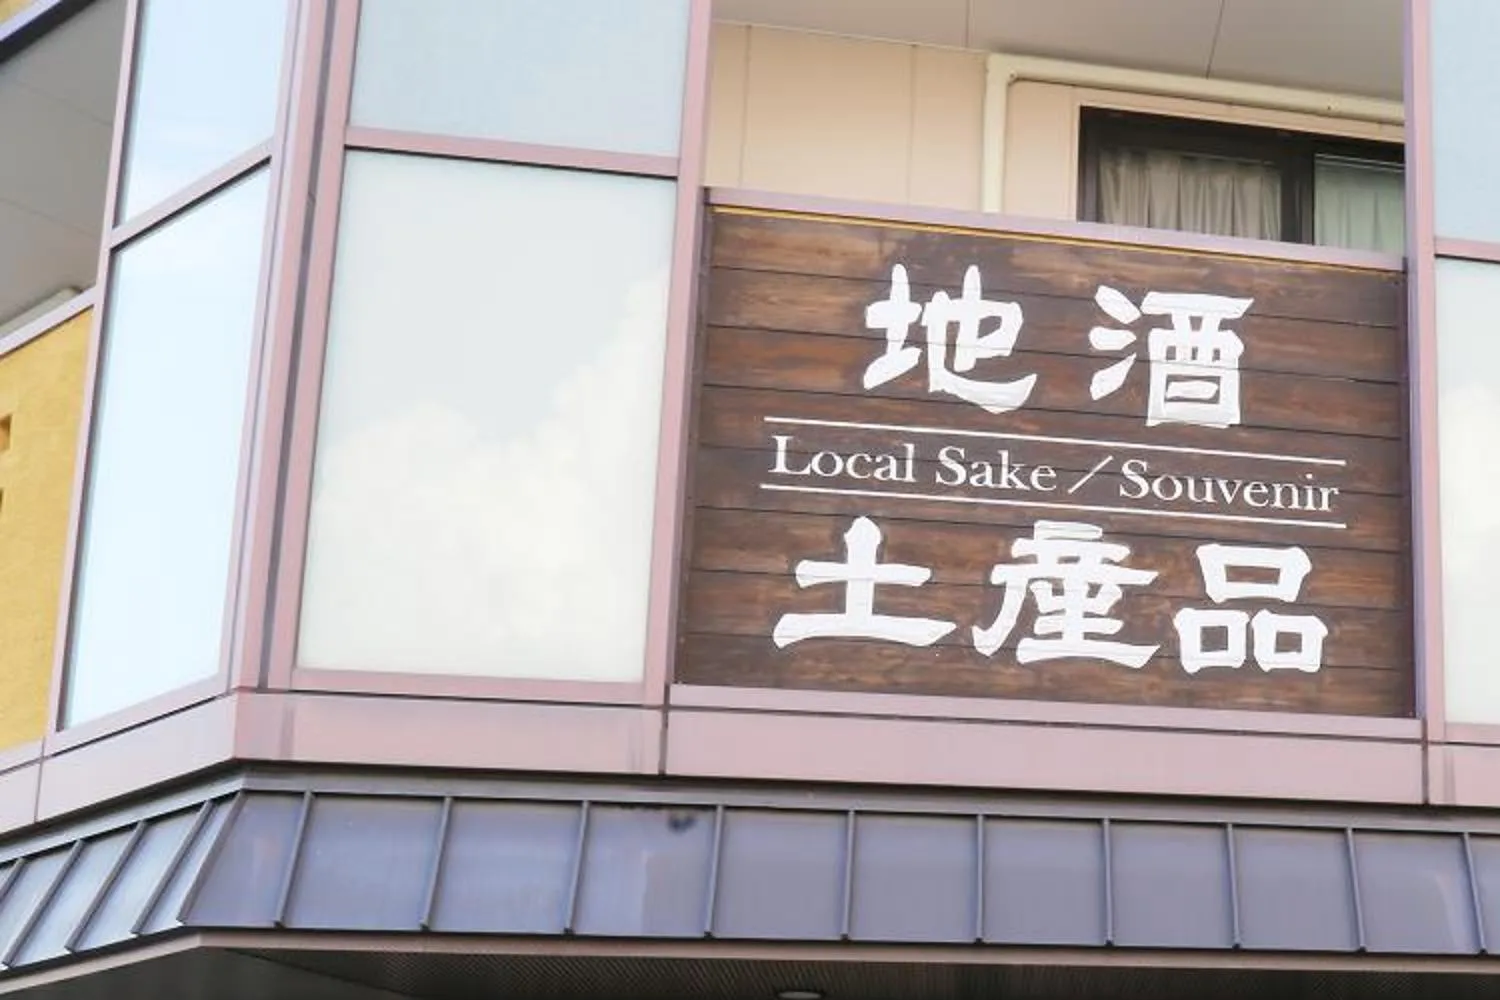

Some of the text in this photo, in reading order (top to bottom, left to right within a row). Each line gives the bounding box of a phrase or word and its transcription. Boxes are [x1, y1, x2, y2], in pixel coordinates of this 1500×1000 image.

[864, 263, 1254, 427] 地酒
[767, 435, 916, 483] Local
[935, 446, 1057, 492] Sake
[1119, 459, 1339, 513] Souvenir
[772, 516, 1328, 673] 土産品
